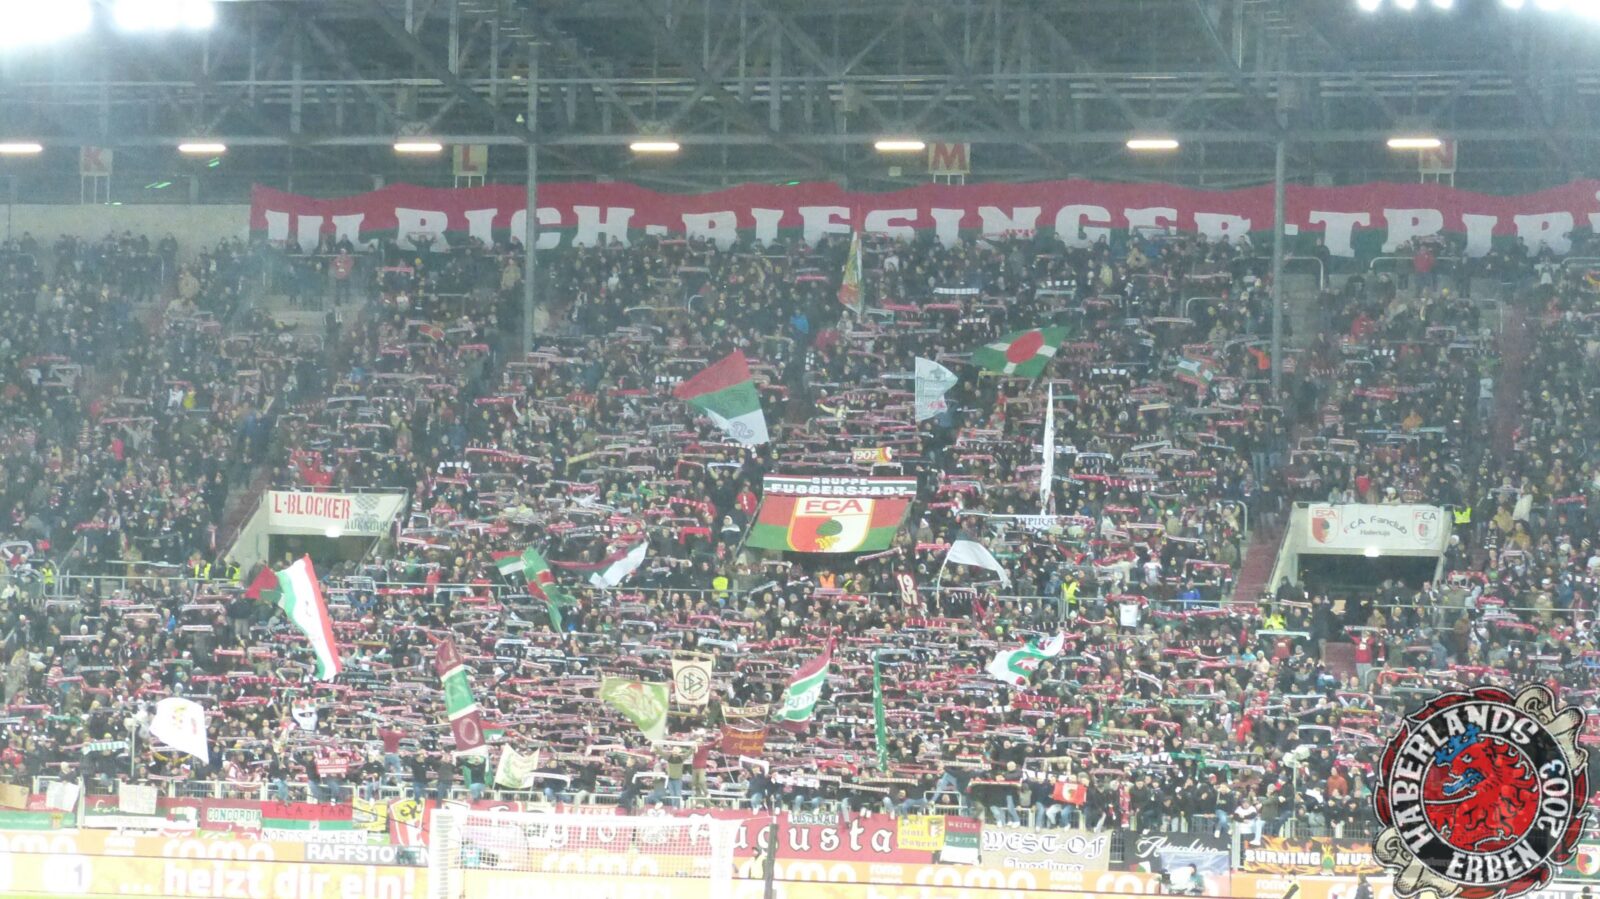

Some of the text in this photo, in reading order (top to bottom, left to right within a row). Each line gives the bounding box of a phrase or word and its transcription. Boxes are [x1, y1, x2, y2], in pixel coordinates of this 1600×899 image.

[932, 143, 965, 170] M
[812, 477, 868, 486] GRUPPE
[804, 499, 864, 514] FCA
[1415, 512, 1437, 521] FCA
[1344, 515, 1408, 535] FCA Fanclub
[206, 808, 262, 821] CONCORDIA
[1245, 849, 1321, 866] BURNING
[163, 861, 266, 897] heizt
[273, 866, 330, 899] dir
[341, 867, 417, 899] ein!
